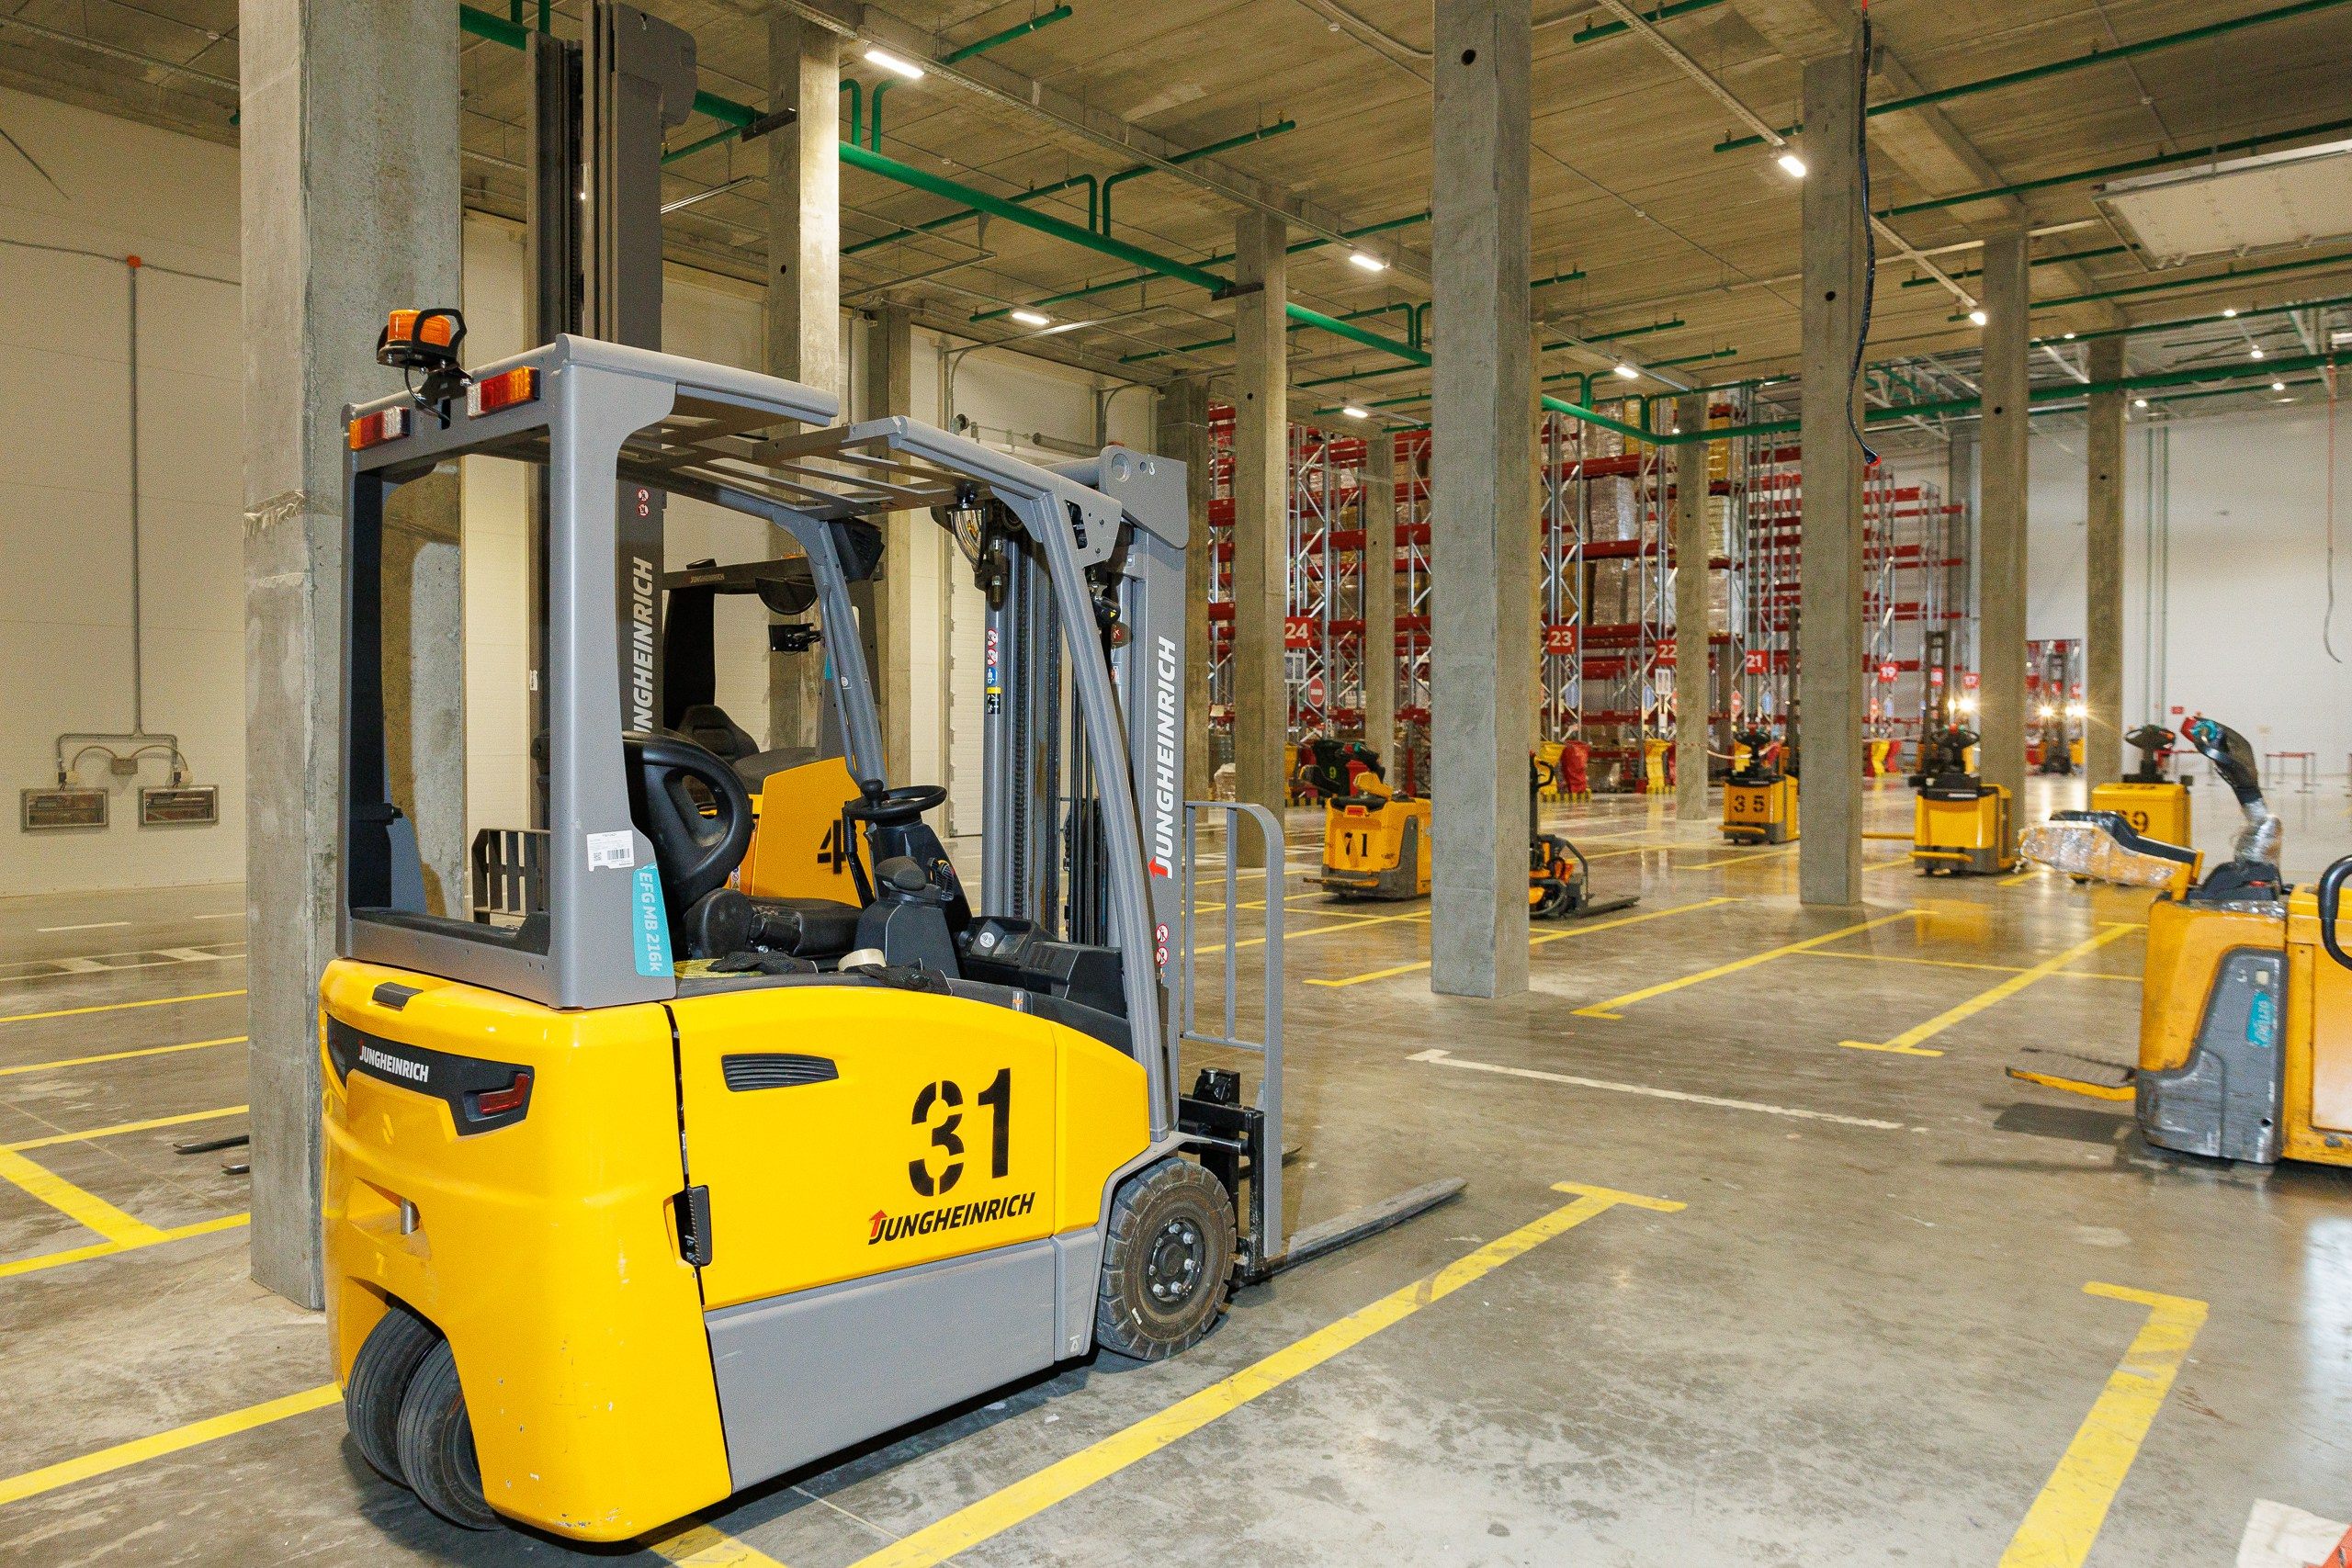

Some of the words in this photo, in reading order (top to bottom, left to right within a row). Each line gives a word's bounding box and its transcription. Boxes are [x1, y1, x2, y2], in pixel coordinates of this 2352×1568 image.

[633, 556, 653, 733] NGHEINRICH
[1285, 622, 1309, 639] 24
[1550, 630, 1572, 646] 23
[1658, 644, 1677, 659] 22
[1746, 654, 1762, 668] 21
[1880, 666, 1896, 678] 19
[1155, 636, 1176, 879] JUNGHEINRICH
[1344, 831, 1368, 857] 71
[639, 872, 655, 904] EFG
[643, 905, 659, 931] MB
[646, 933, 663, 972] 216k
[358, 1045, 430, 1083] JUNGHEINRICH
[908, 1066, 1011, 1197] 31
[867, 1191, 1036, 1246] JUNGHEINRICH
